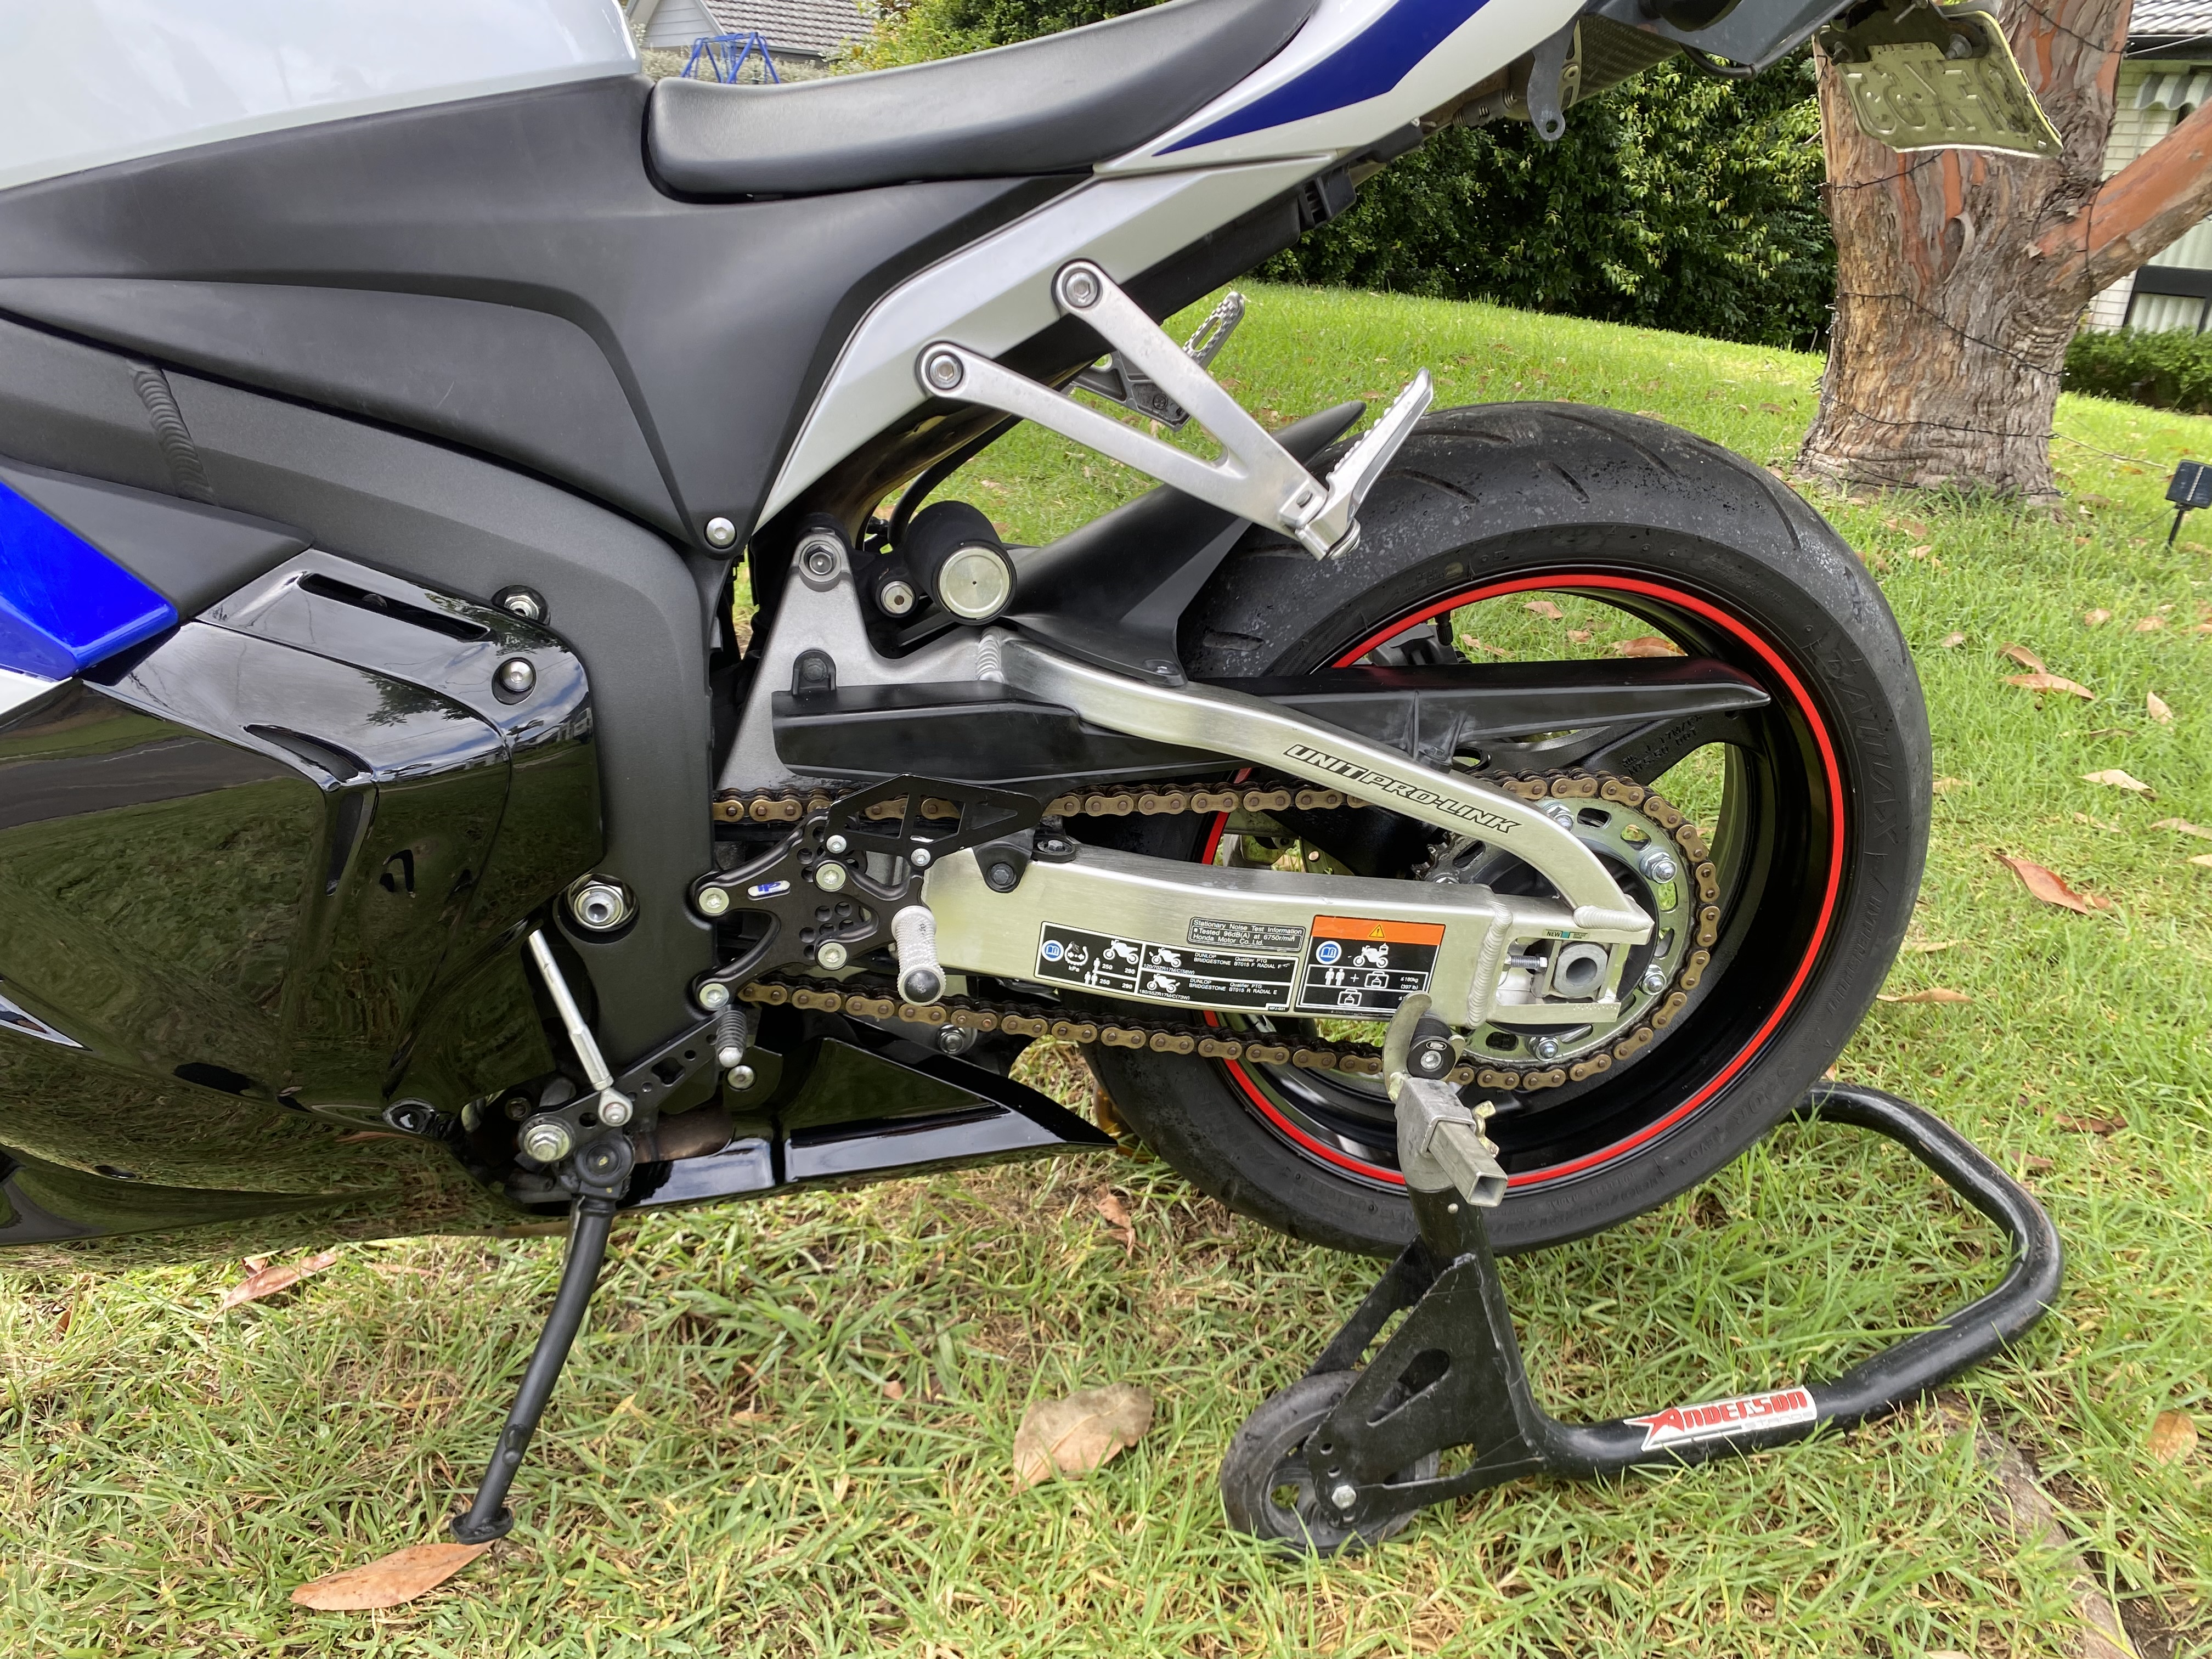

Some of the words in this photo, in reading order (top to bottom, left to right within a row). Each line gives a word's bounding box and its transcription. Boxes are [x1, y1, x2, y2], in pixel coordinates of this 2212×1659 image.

[1193, 919, 1226, 929] Stationary
[1199, 928, 1220, 936] Tested
[1223, 930, 1250, 939] 96dB(A)
